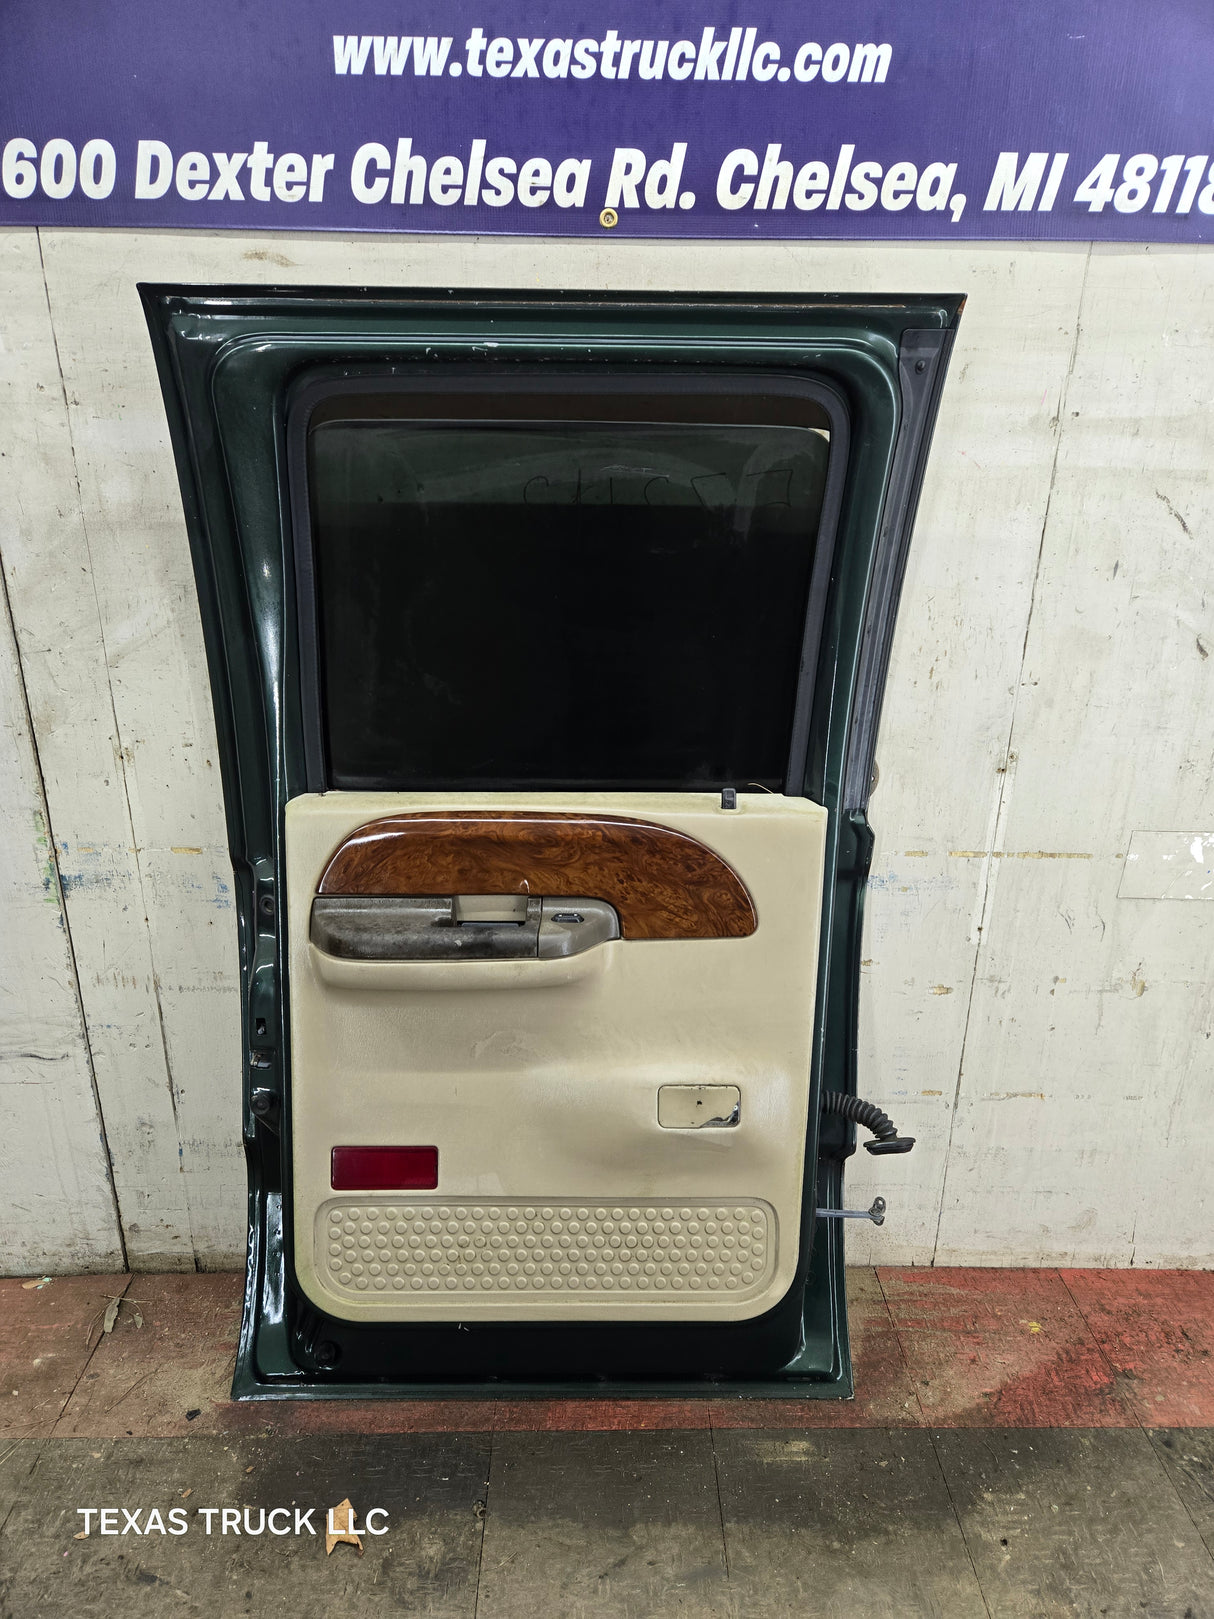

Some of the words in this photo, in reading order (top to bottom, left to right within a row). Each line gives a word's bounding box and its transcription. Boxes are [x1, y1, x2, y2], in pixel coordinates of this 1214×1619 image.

[332, 26, 893, 84] www.texastruckllc.com
[1, 137, 117, 200] 600
[134, 138, 335, 204] Dexter
[350, 137, 592, 209] Chelsea
[604, 142, 696, 210] Rd.
[716, 143, 967, 223] Chelsea,
[982, 151, 1070, 213] MI
